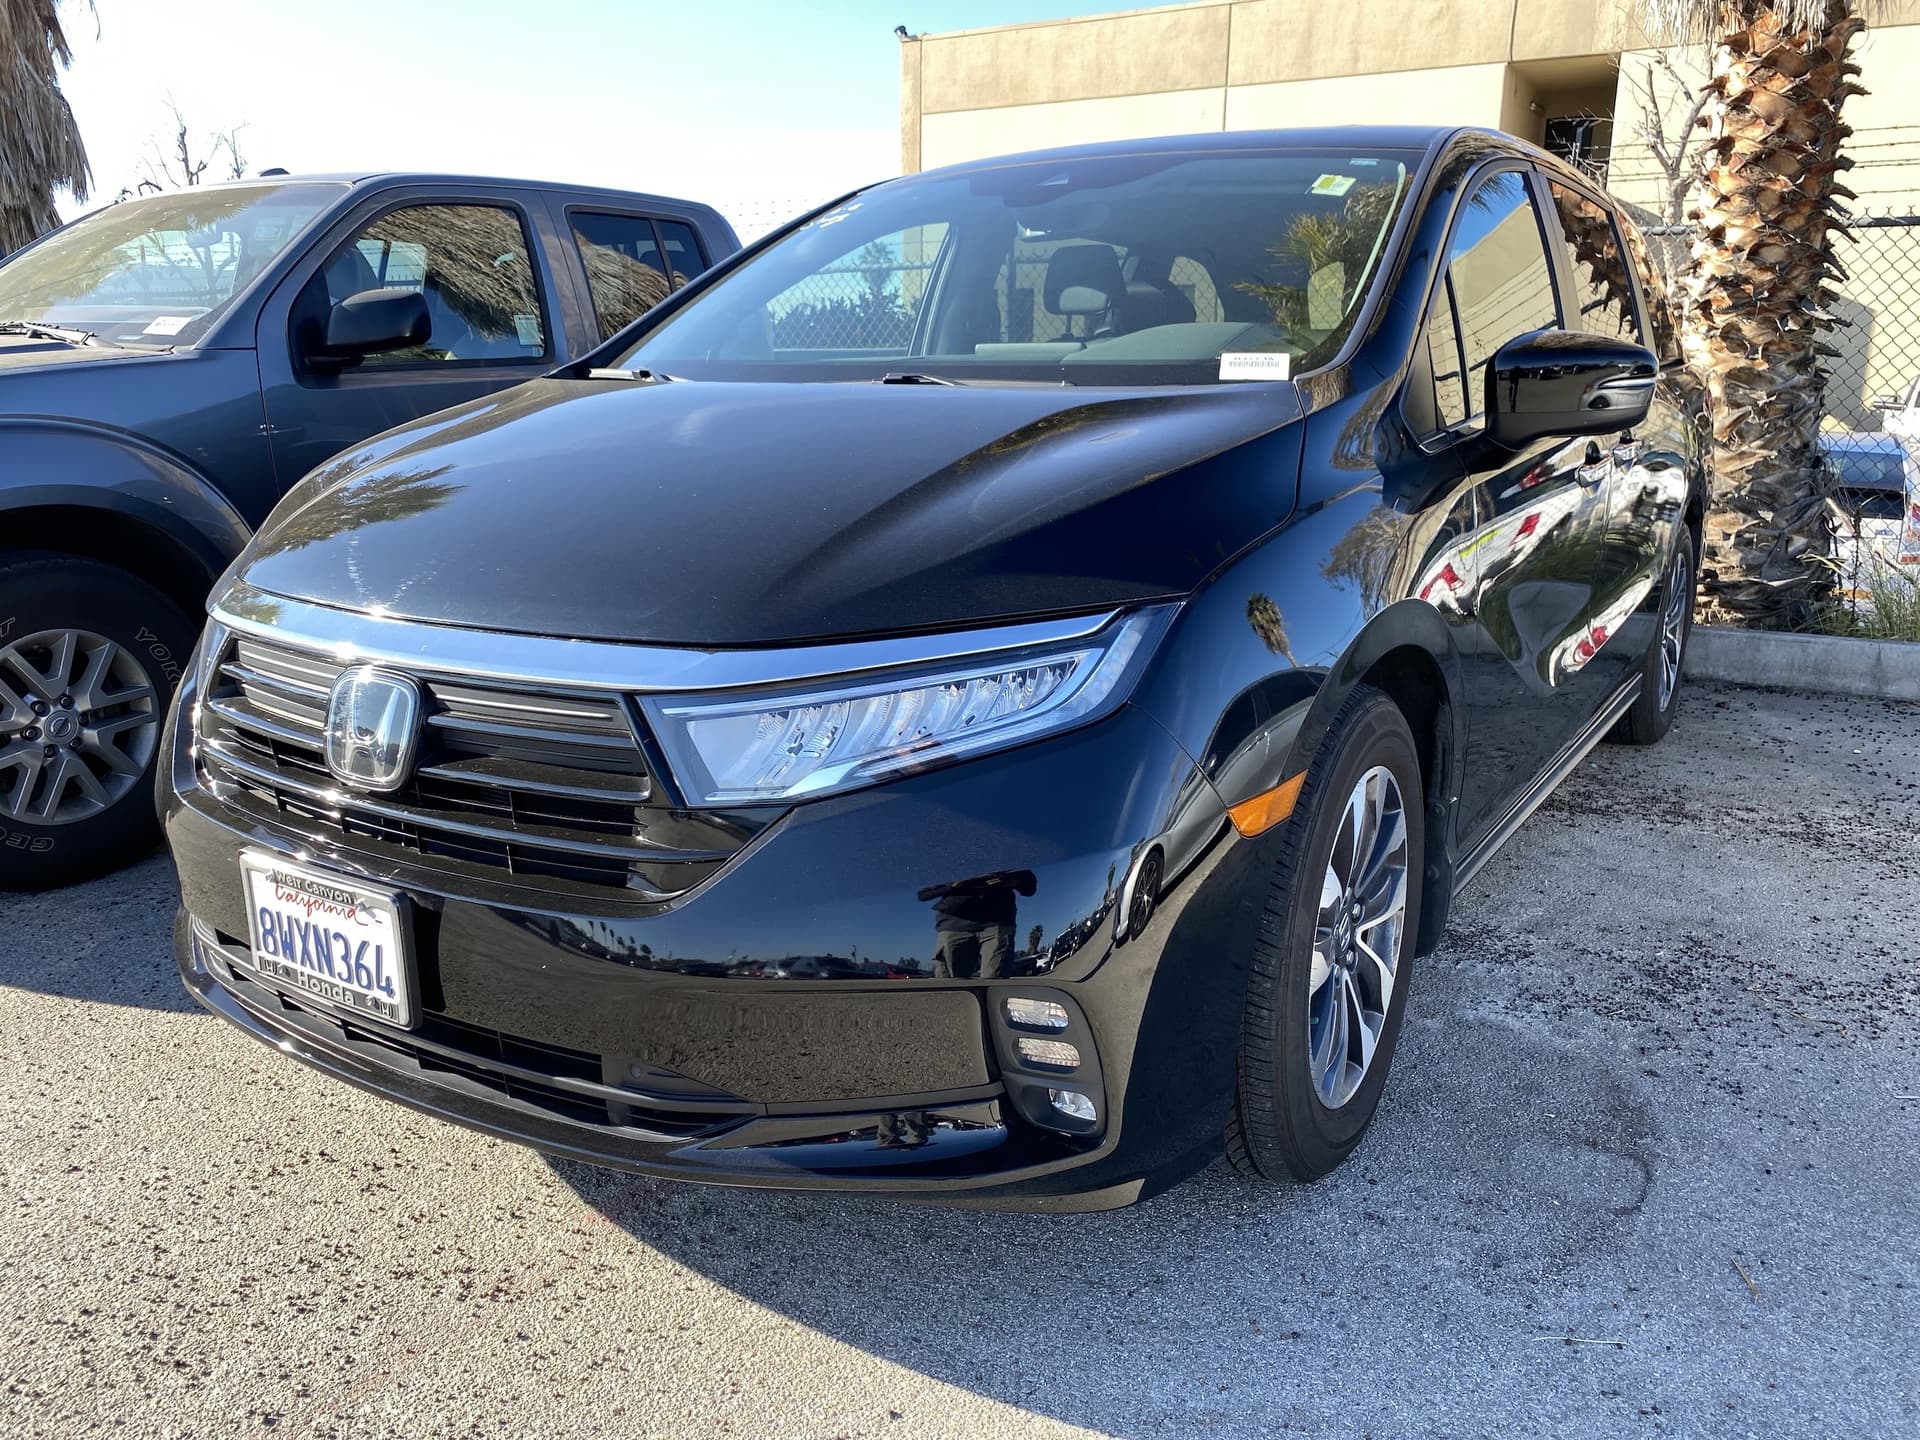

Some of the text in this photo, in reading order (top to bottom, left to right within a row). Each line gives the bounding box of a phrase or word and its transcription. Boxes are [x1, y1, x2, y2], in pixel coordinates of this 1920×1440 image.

[274, 882, 369, 927] California
[276, 869, 354, 905] Weir Canyon
[258, 906, 396, 999] 8WXN364
[297, 969, 356, 1006] Honda
